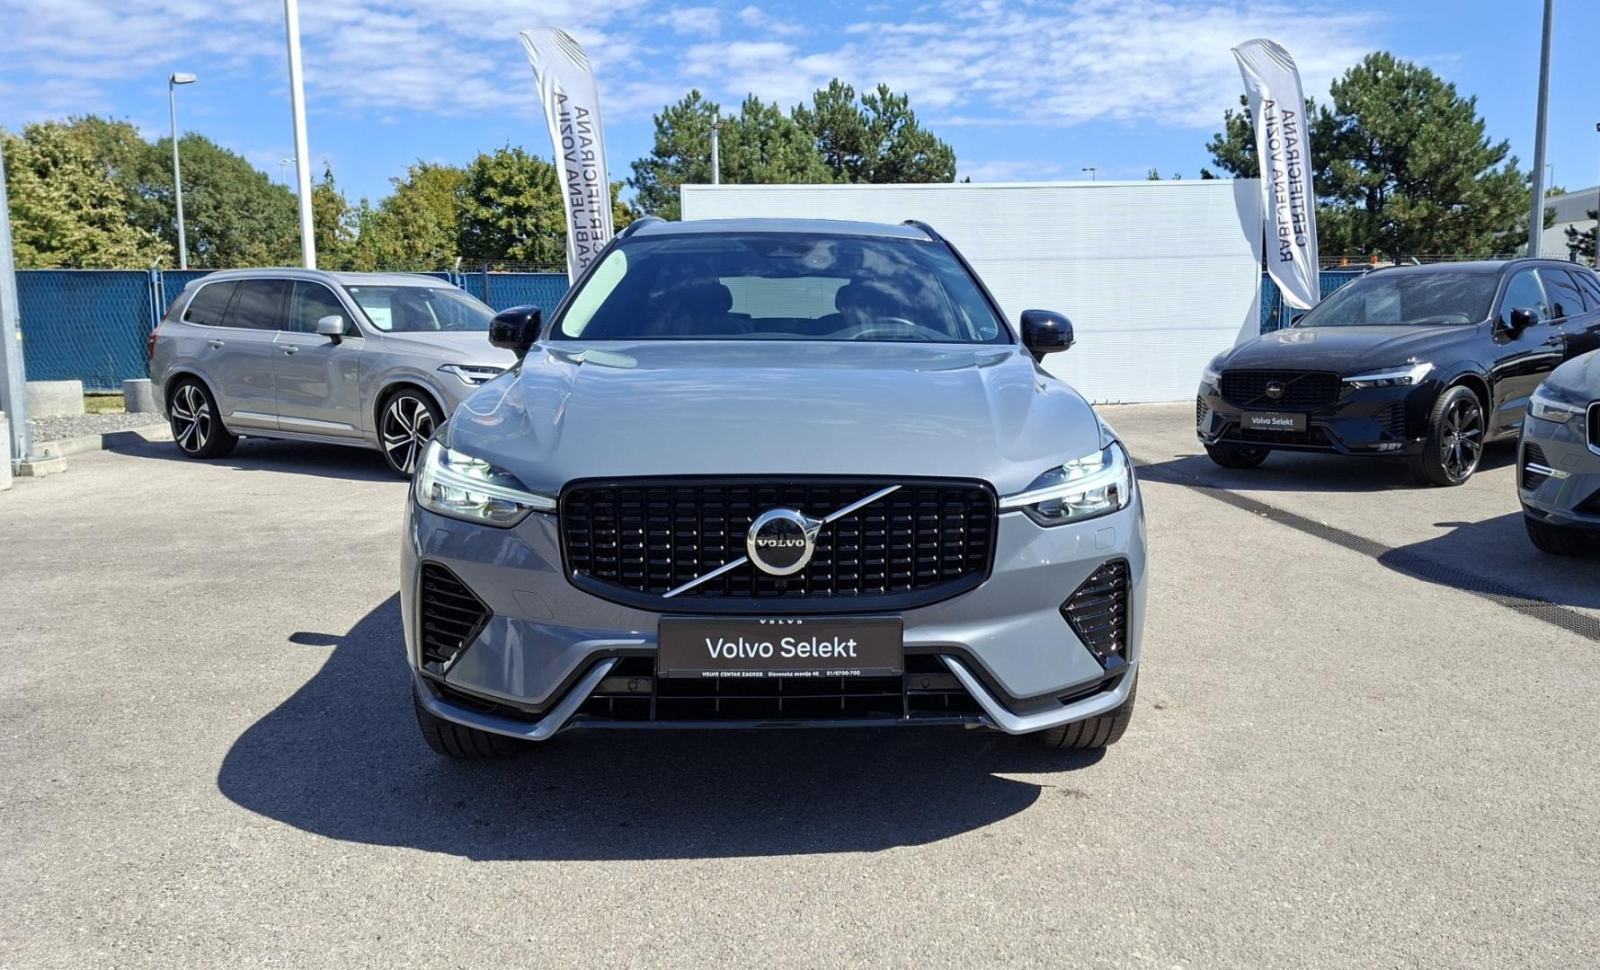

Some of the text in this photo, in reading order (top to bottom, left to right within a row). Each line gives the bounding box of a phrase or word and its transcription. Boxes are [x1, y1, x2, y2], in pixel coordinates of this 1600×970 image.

[1251, 417, 1294, 426] Volvo Selekt
[757, 539, 805, 547] VOLVO
[705, 637, 857, 659] Volvo Selekt
